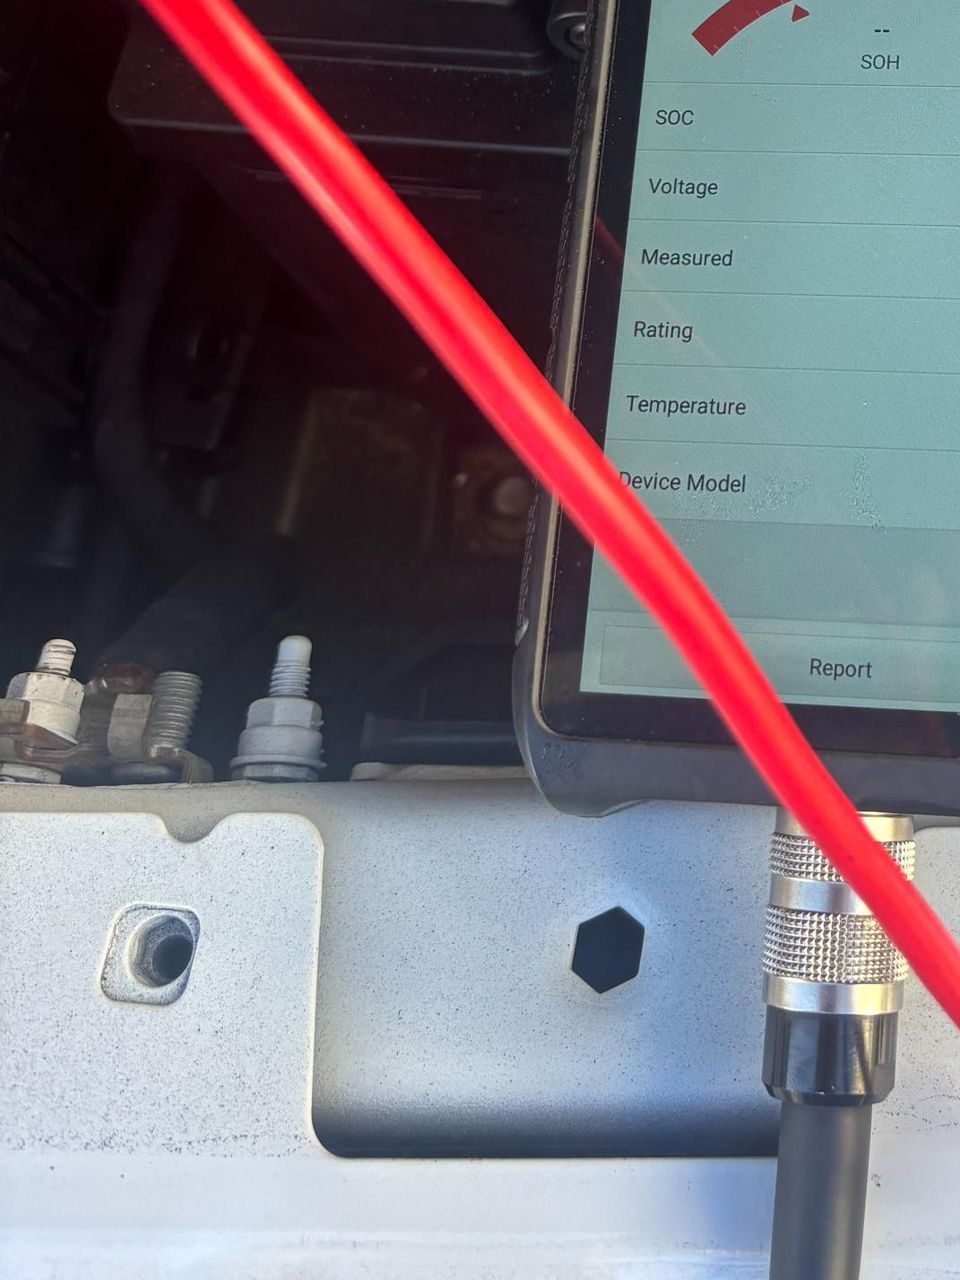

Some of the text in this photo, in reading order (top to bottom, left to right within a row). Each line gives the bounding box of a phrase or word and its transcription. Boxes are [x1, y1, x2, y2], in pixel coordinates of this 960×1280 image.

[860, 53, 901, 71] SOH
[654, 109, 695, 126] SOC
[648, 177, 719, 198] Voltage
[640, 248, 733, 267] Measured
[633, 321, 693, 344] Rating
[625, 395, 747, 419] Temperature
[618, 471, 747, 493] Device Model
[809, 657, 873, 680] Report
